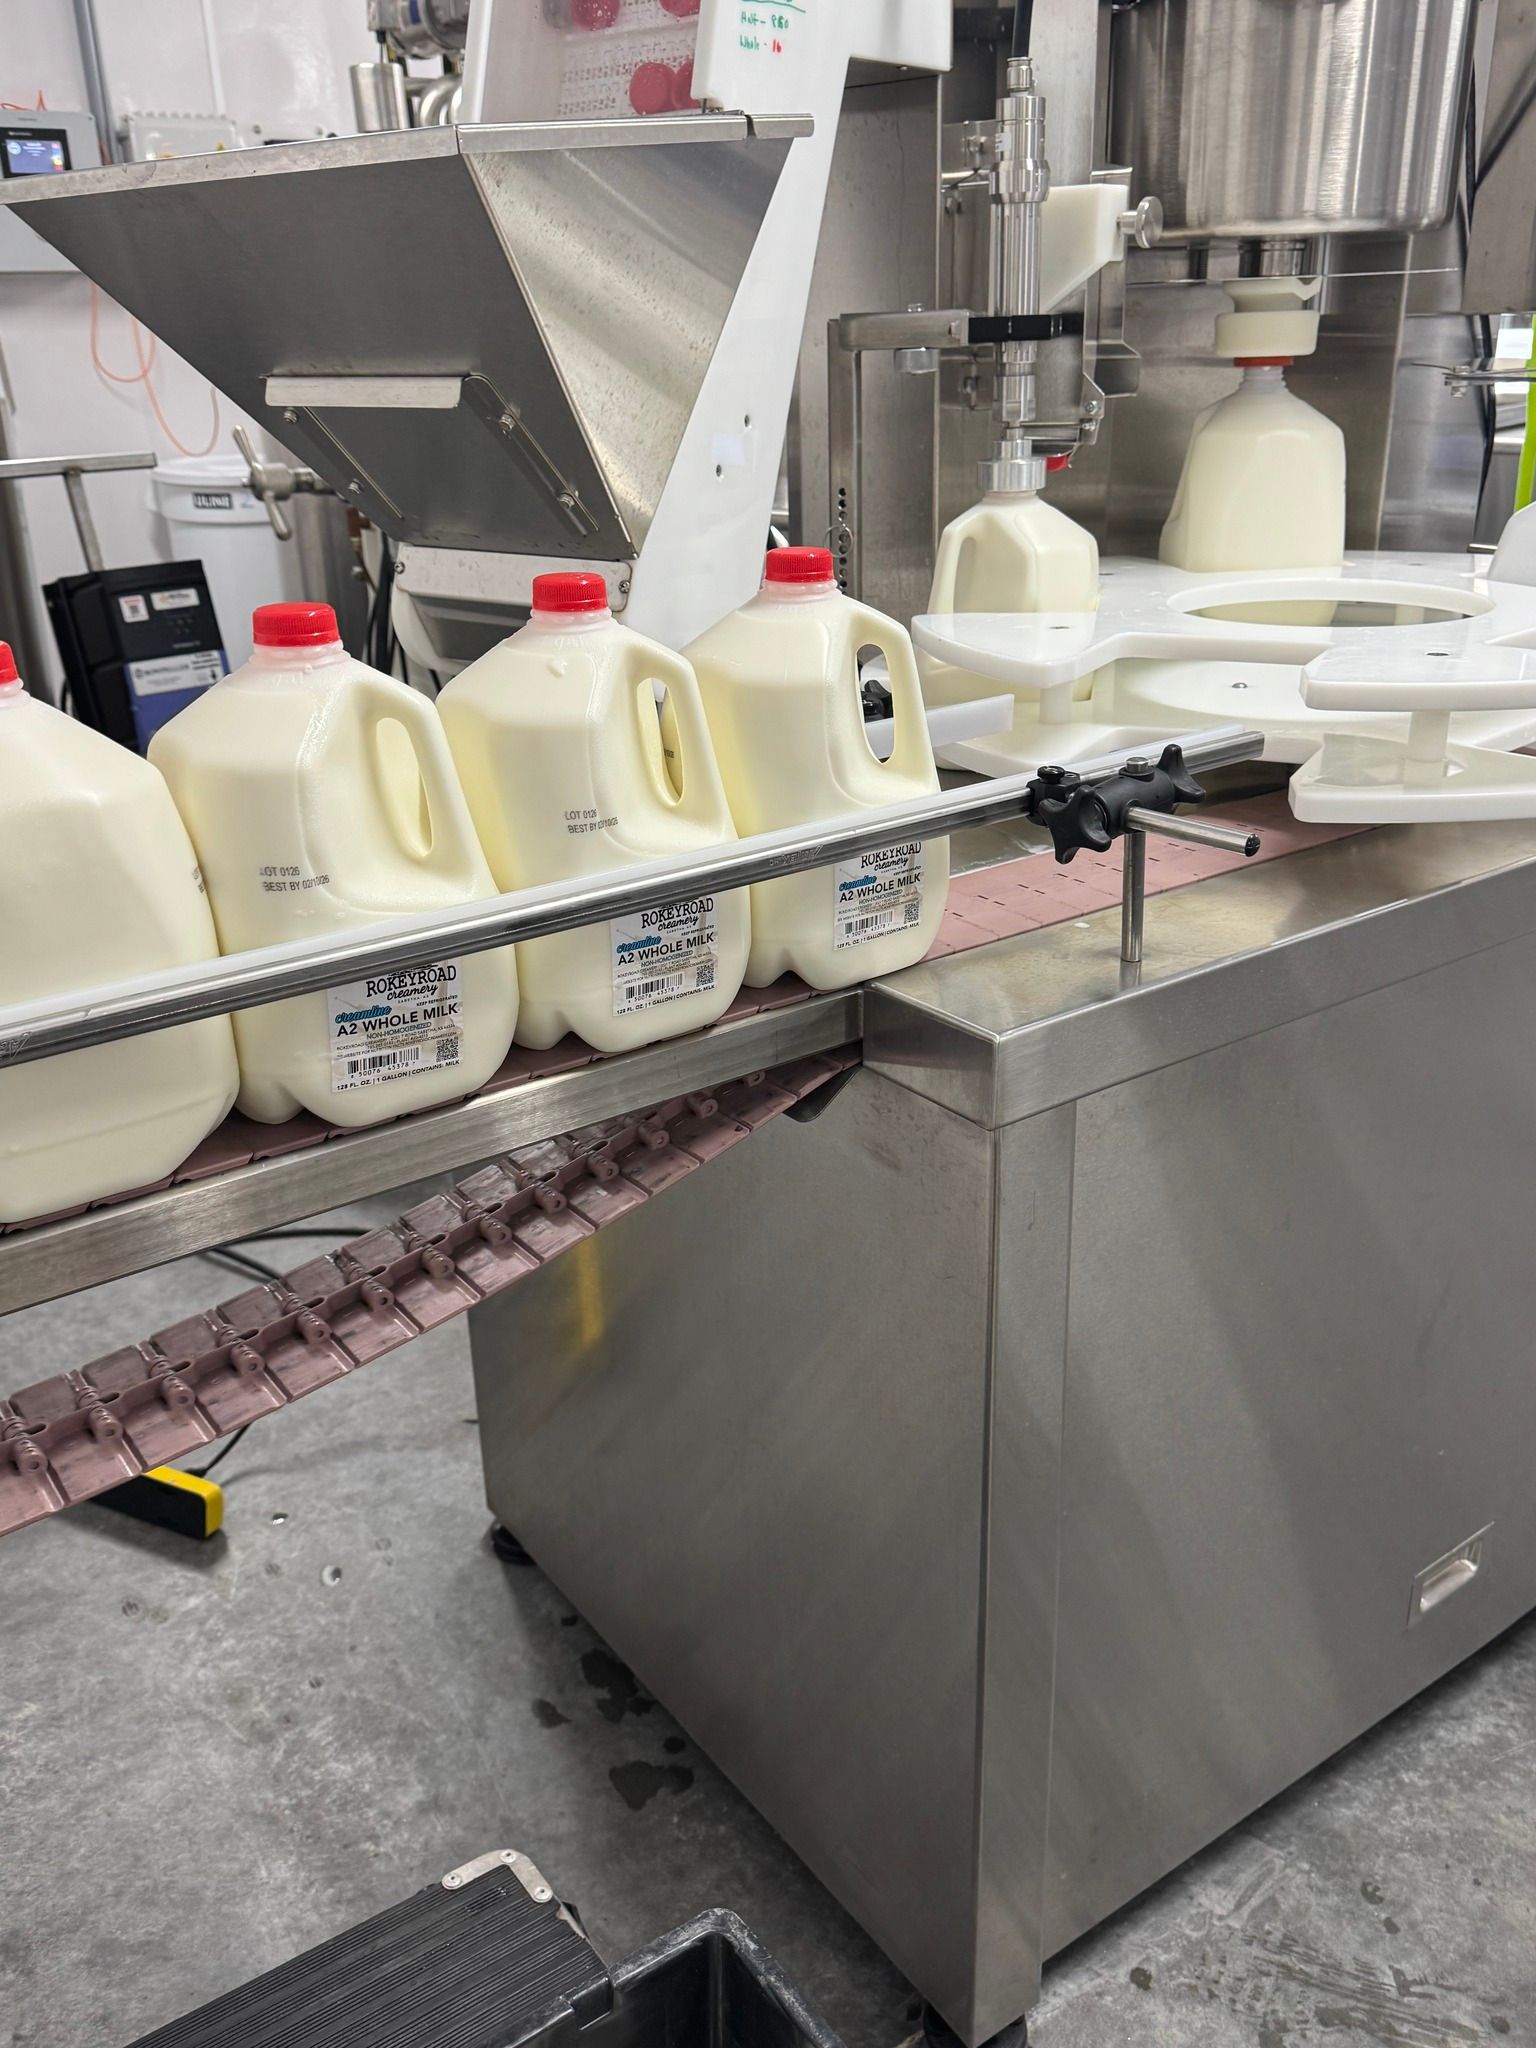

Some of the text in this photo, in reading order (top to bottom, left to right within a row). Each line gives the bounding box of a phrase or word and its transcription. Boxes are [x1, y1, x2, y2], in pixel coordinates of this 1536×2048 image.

[564, 811, 580, 820] LOT
[568, 824, 588, 833] BEST
[590, 823, 597, 831] BY
[861, 842, 921, 868] ROKEYROAD
[260, 866, 300, 876] LOT 0126
[874, 857, 908, 871] creamery
[263, 882, 287, 891] BEST
[290, 881, 300, 891] BY
[840, 873, 921, 902] A2 WHOLE MILK
[641, 898, 713, 928] ROKEYROAD
[657, 915, 698, 931] creamery
[618, 932, 714, 966] A2 WHOLE MILK
[366, 965, 456, 997] ROKEYROAD
[387, 984, 438, 1000] creamery
[652, 997, 673, 1005] GALLON
[335, 1005, 392, 1024] creamline
[337, 1002, 458, 1037] A2 WHOLE MILK
[366, 1022, 432, 1040] NON-HOMOGENIZED
[381, 1072, 407, 1081] GALLON
